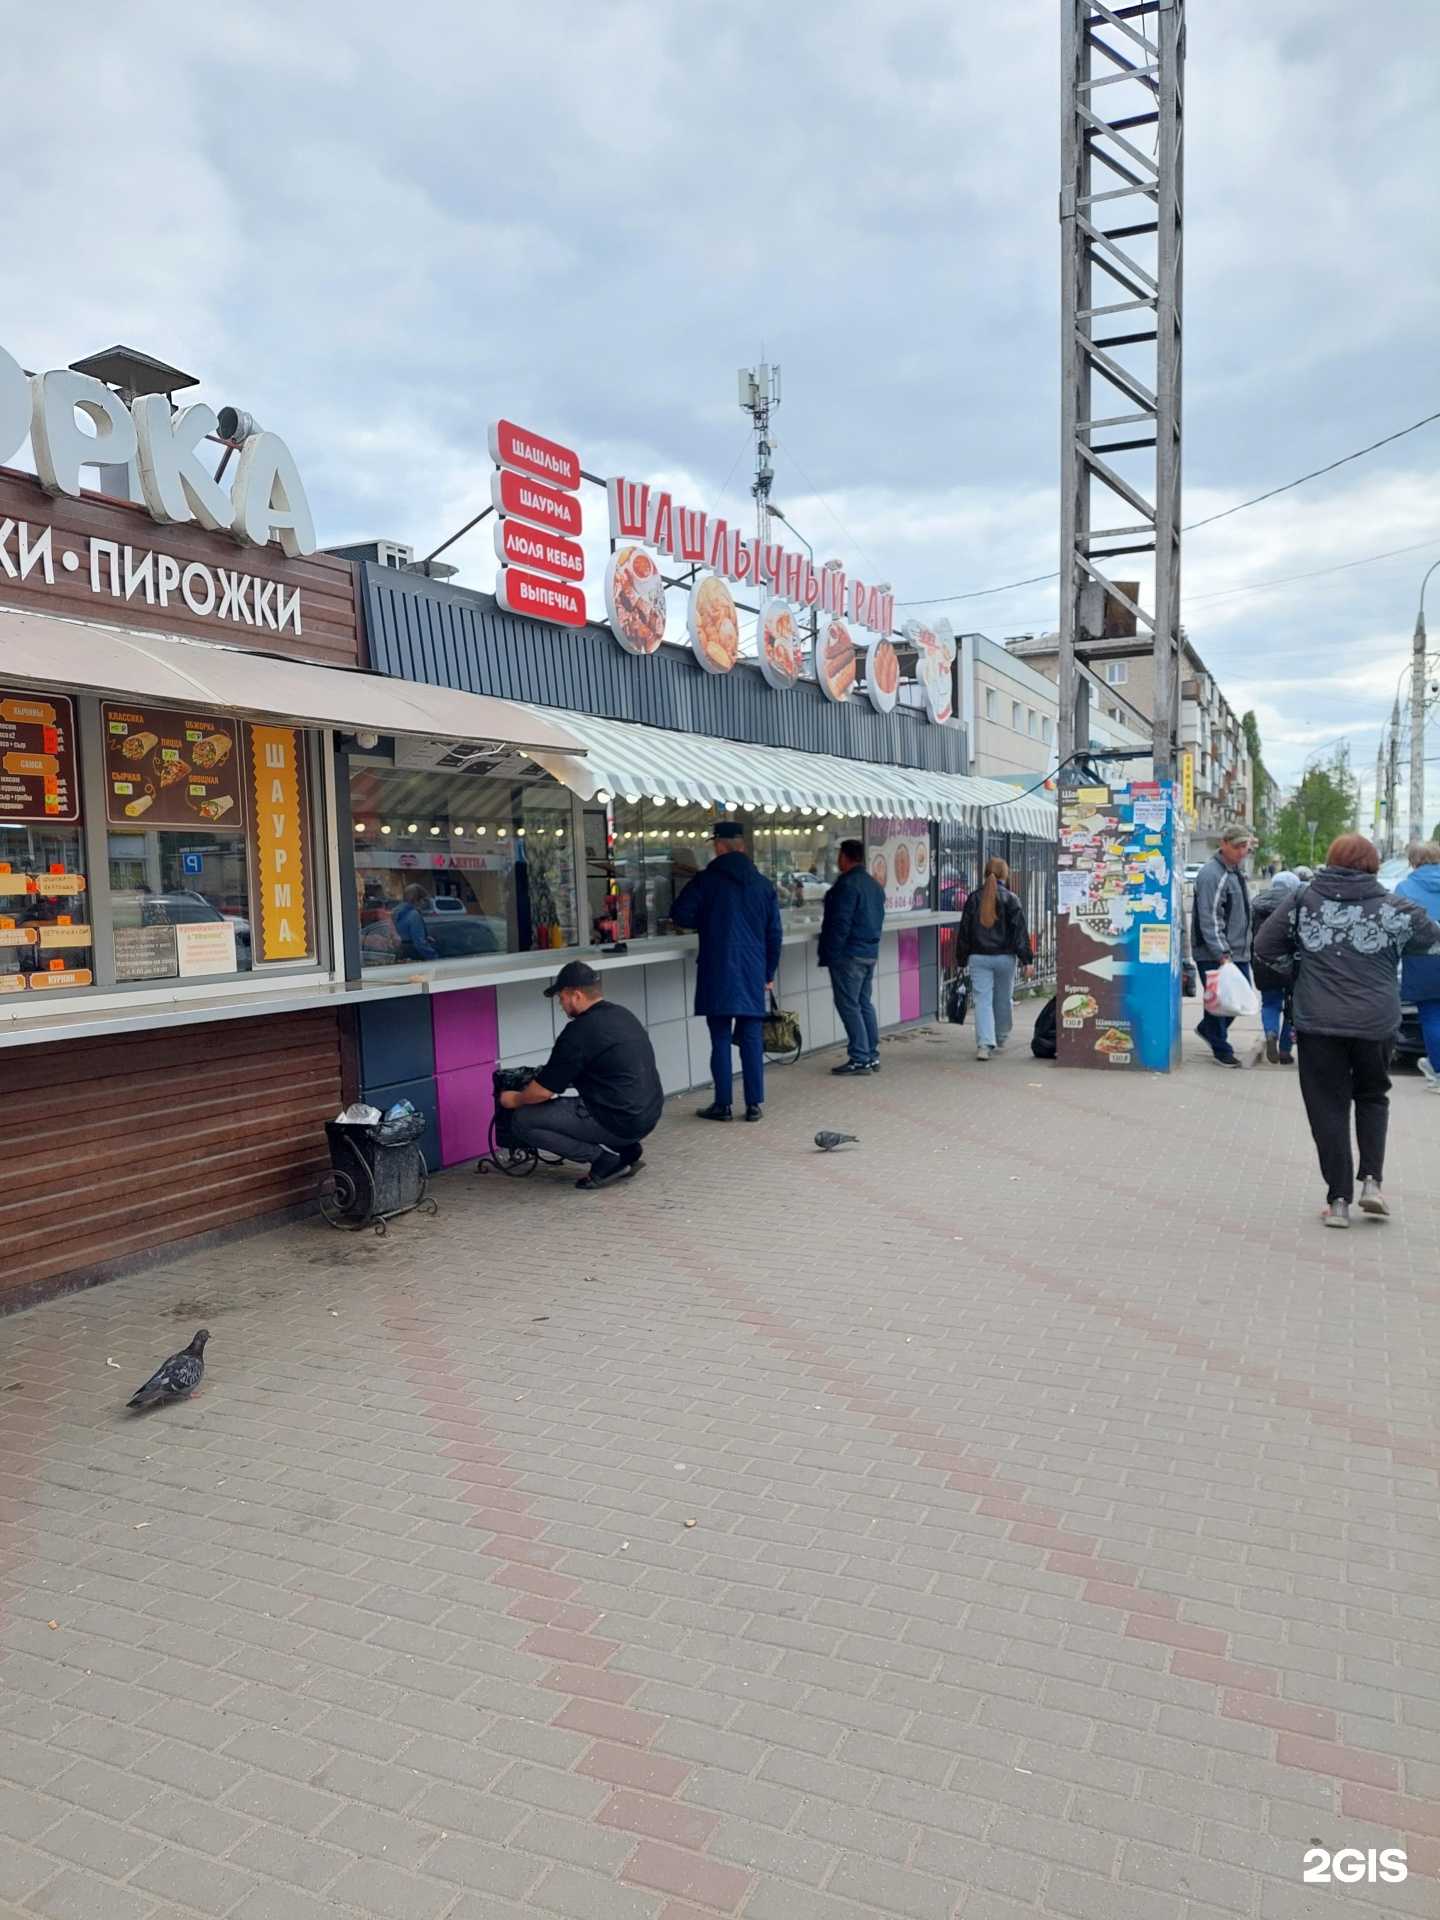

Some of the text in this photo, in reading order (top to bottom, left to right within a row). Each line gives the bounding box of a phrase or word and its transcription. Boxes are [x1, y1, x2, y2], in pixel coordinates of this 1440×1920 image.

[512, 438, 572, 478] ШАШЛЫК
[520, 488, 572, 522] ШАУРМА
[507, 534, 583, 572] ЛЮЛЯ КЕБАБ
[614, 476, 847, 617] ШАШЛЫЧНЫЙ
[90, 536, 302, 636] ПИРОЖКИ
[520, 582, 579, 613] ВЫПЕЧКА
[265, 743, 292, 943] ШАУРМА
